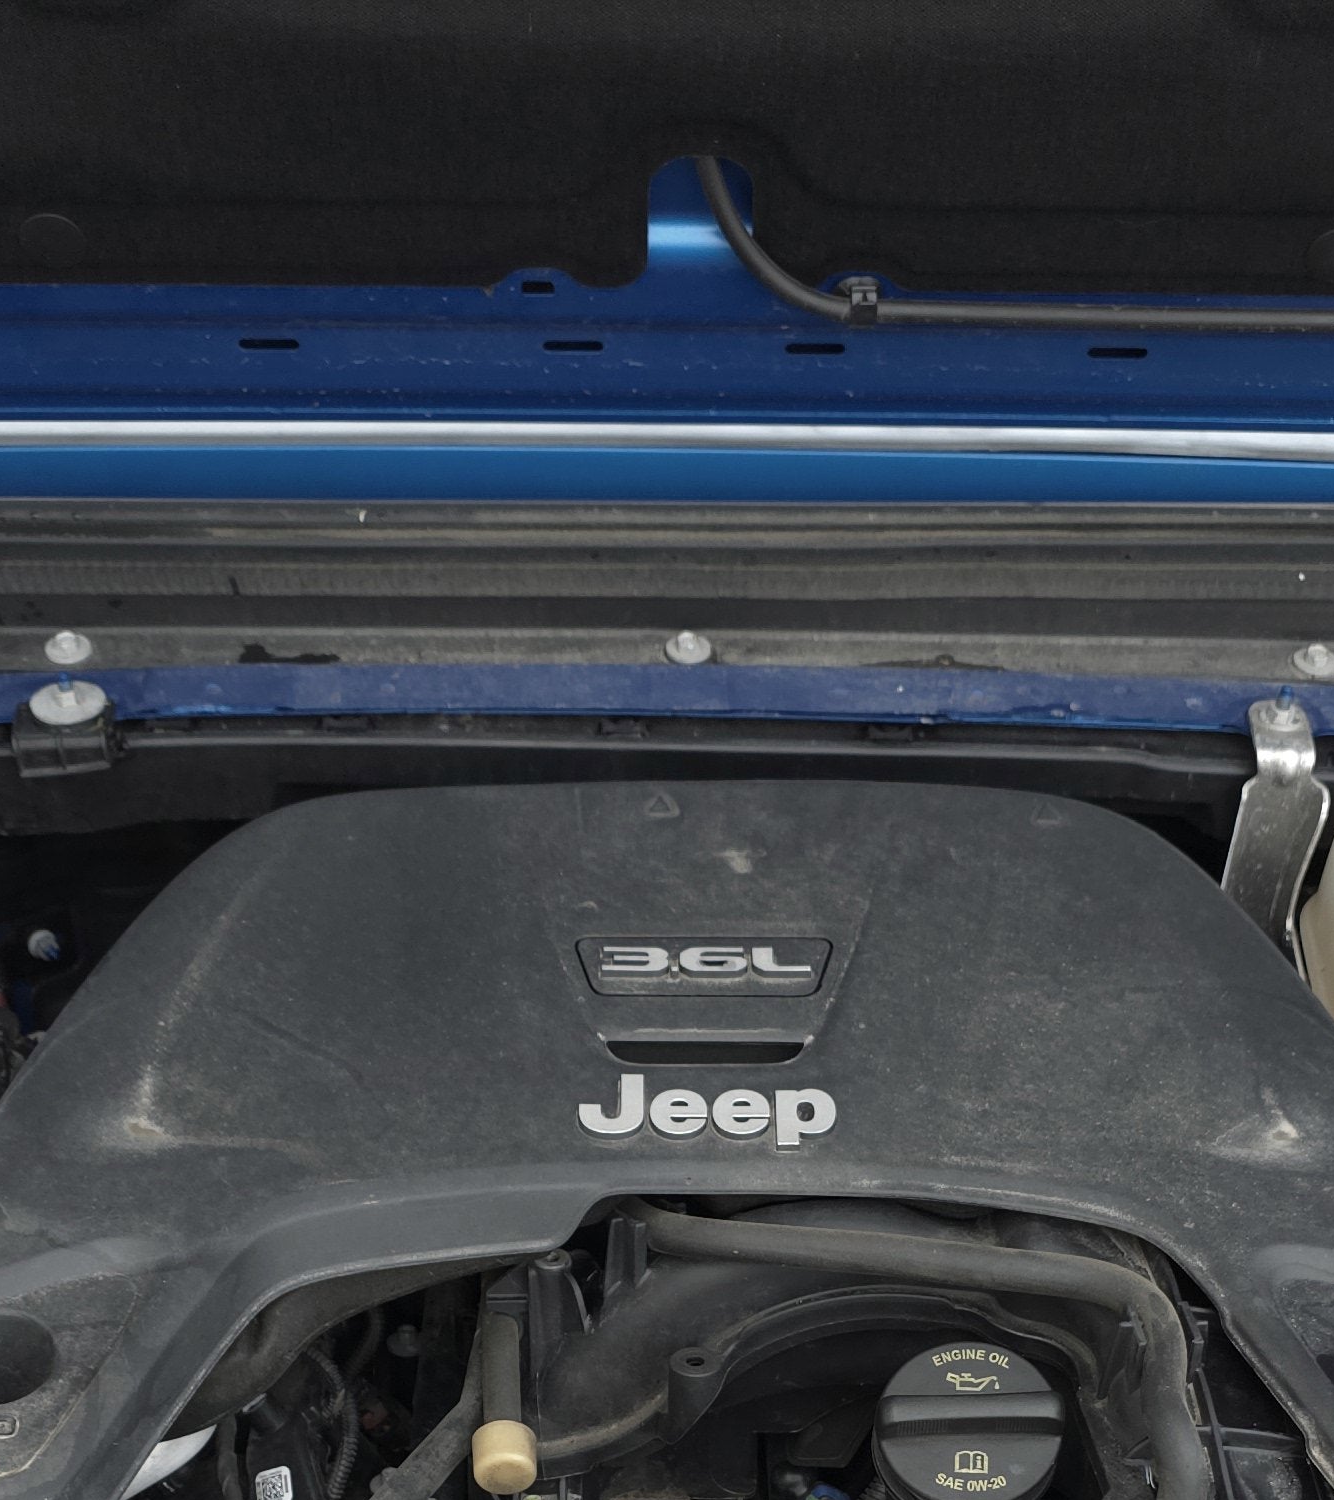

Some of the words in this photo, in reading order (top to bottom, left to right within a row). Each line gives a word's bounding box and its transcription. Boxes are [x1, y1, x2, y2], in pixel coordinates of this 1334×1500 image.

[600, 946, 812, 979] 3.6L
[578, 1073, 837, 1152] Jeep
[932, 1348, 986, 1368] ENGINE
[988, 1352, 1011, 1369] OIL
[935, 1472, 963, 1491] SAE
[967, 1475, 1007, 1492] 0W-20
